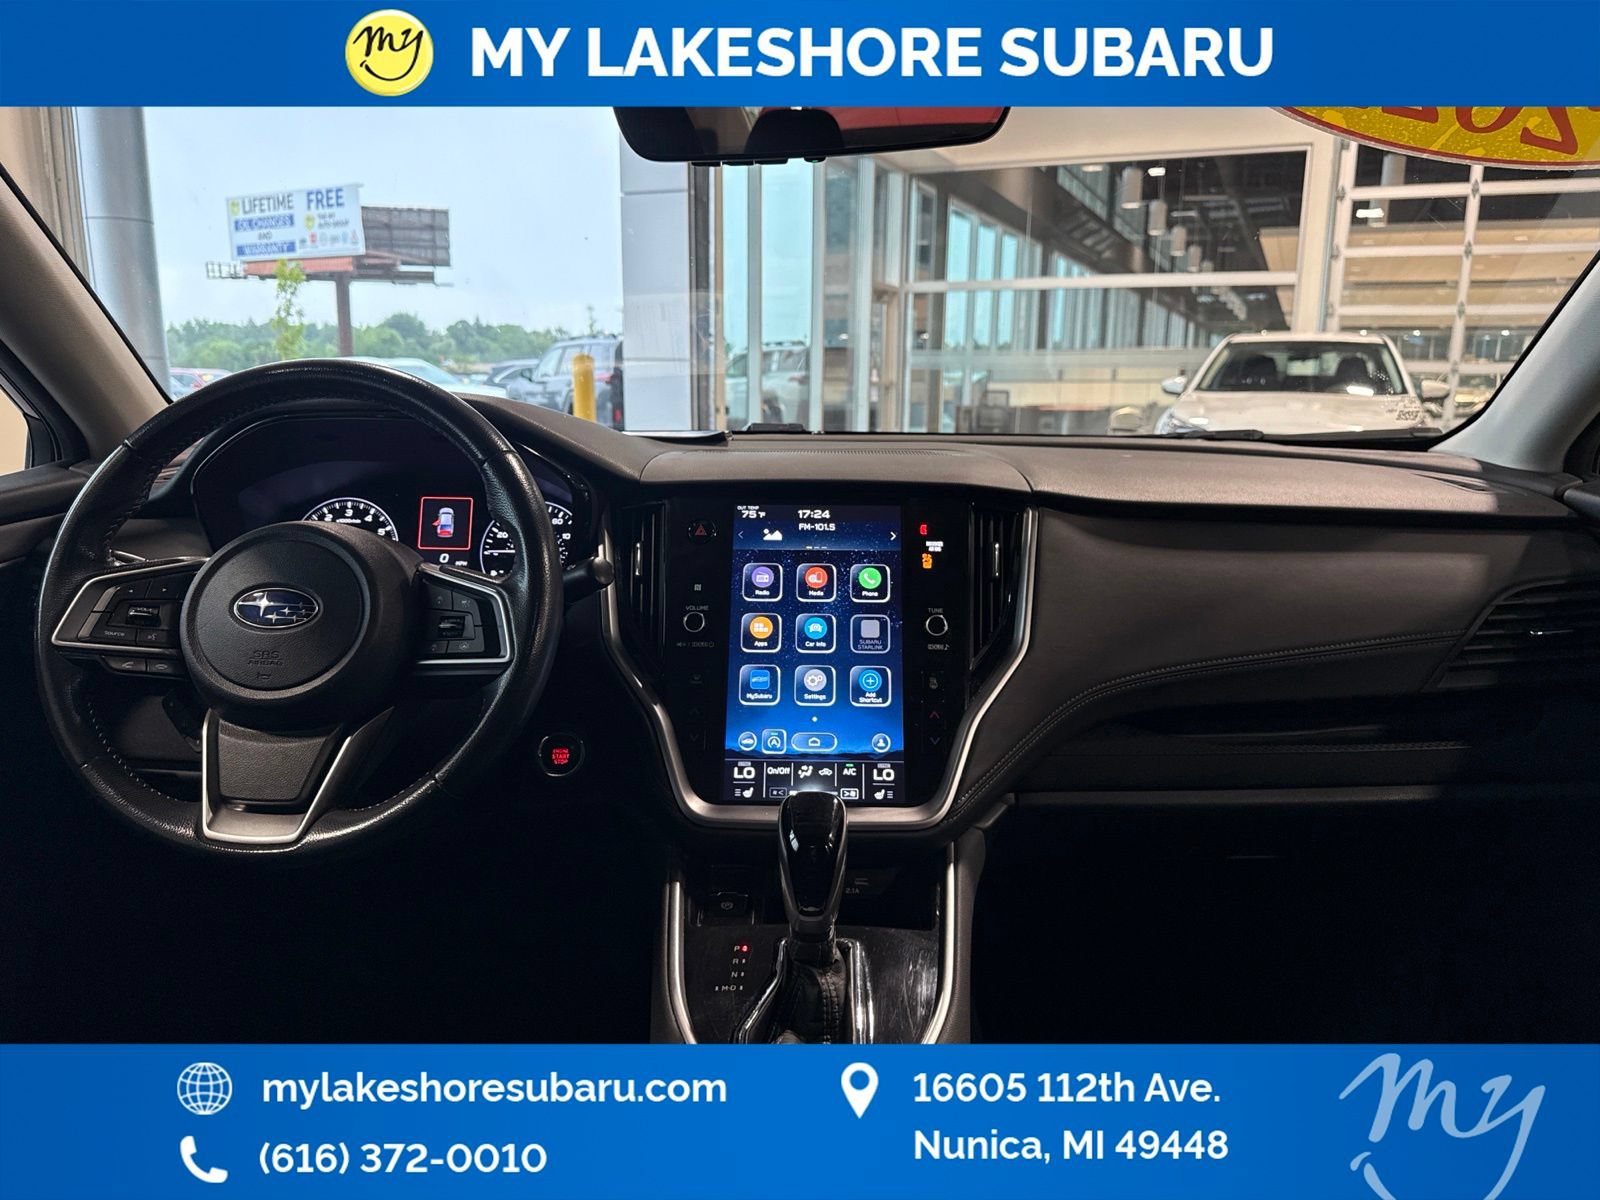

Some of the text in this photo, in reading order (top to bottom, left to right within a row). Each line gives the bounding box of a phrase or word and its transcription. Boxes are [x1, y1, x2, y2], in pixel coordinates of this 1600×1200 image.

[242, 193, 294, 214] LIFETIME
[306, 188, 345, 210] FREE
[344, 509, 353, 517] 3
[798, 510, 830, 519] 17:24
[324, 514, 333, 522] 2
[364, 514, 373, 522] 4
[798, 523, 836, 531] FM-101.5
[377, 528, 385, 536] 5
[439, 553, 449, 563] 0
[733, 766, 756, 779] LO
[767, 766, 791, 775] On/Off
[843, 768, 857, 776] A/C
[873, 768, 895, 781] LO
